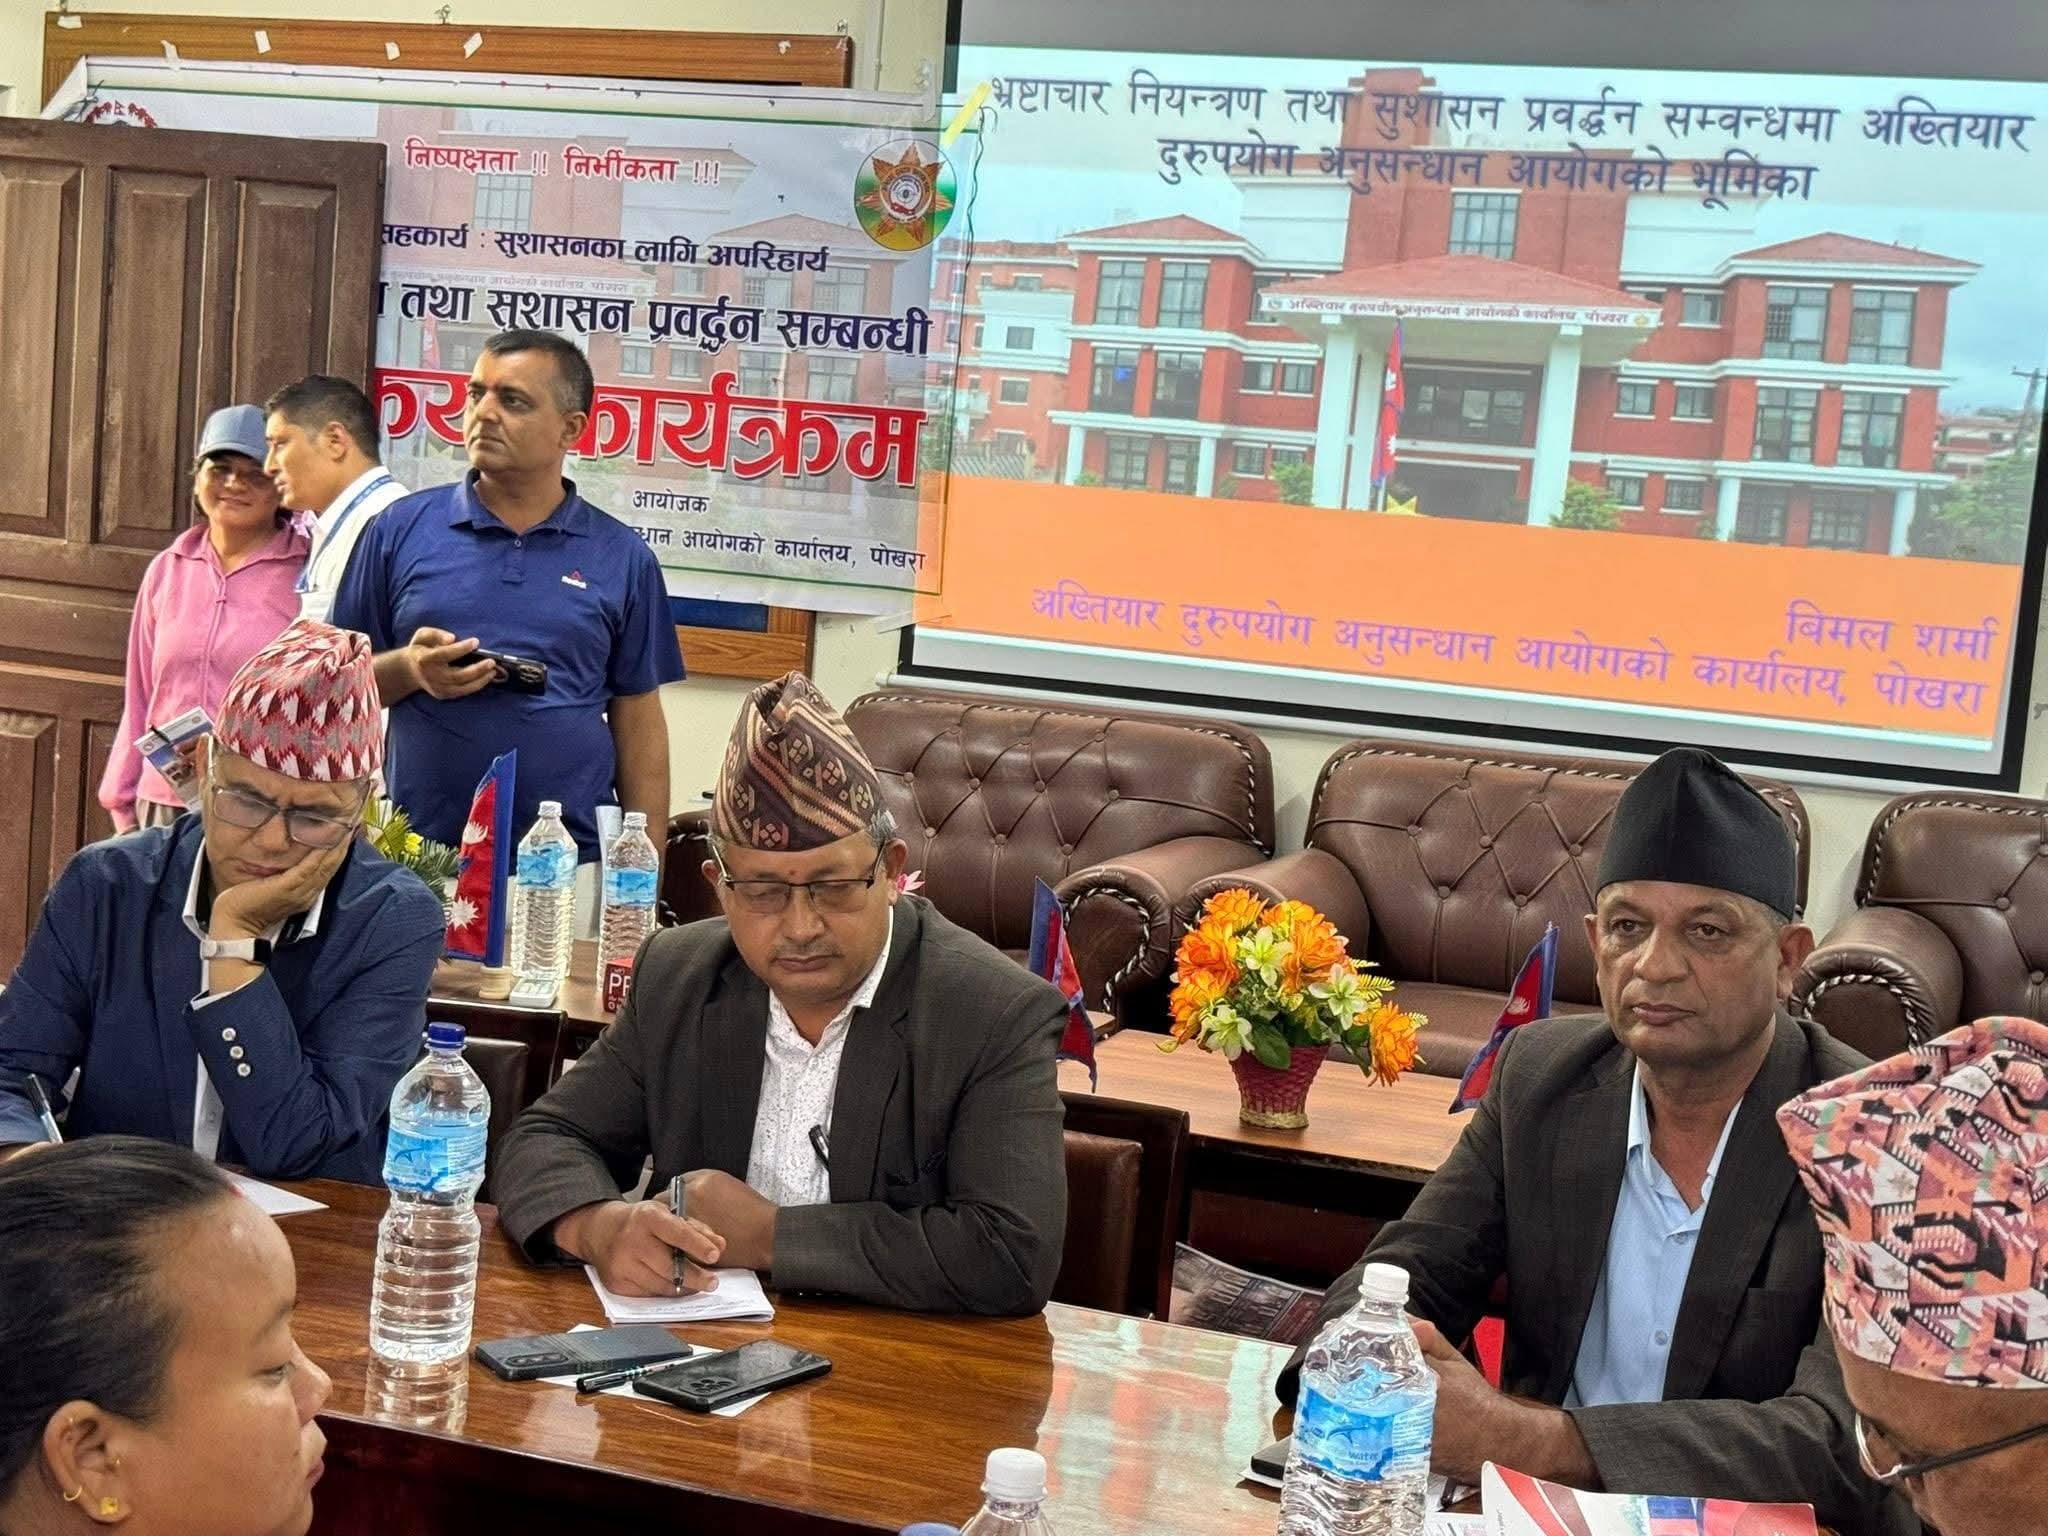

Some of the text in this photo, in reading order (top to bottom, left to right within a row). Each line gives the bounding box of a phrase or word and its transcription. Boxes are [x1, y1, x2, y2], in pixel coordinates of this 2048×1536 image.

[992, 76, 1111, 114] भ्रष्टाचार
[1128, 69, 1268, 119] नियन्त्रण
[1285, 88, 1352, 124] तथा
[1373, 92, 1505, 140] सुशासन
[1524, 86, 1643, 138] प्रवर्द्धन
[1863, 95, 2036, 153] अख्तियार
[405, 137, 518, 174] निष्पक्षता
[564, 146, 679, 182] निर्भीकता
[1156, 128, 1820, 211] दुरुपयोग अनुसन्धान आयोगको भूमिका
[495, 231, 627, 259] सुशासनका
[634, 235, 699, 264] लागि
[707, 244, 829, 273] अपरिहार्य
[401, 283, 474, 321] तथा
[486, 289, 634, 333] सुशासन
[777, 307, 933, 354] सम्बन्धी
[566, 372, 926, 486] कार्यक्रम
[632, 488, 710, 513] आयोजक
[682, 529, 765, 556] आयोगको
[869, 546, 927, 574] पोखरा
[1032, 579, 1166, 632] अख्तियार
[1178, 600, 1317, 647] दुरुपयोग
[1334, 618, 1498, 666] अनुसन्धान
[1514, 630, 1676, 681] आयोगको
[1872, 659, 1989, 714] पोखरा
[1914, 616, 1999, 662] शर्मा
